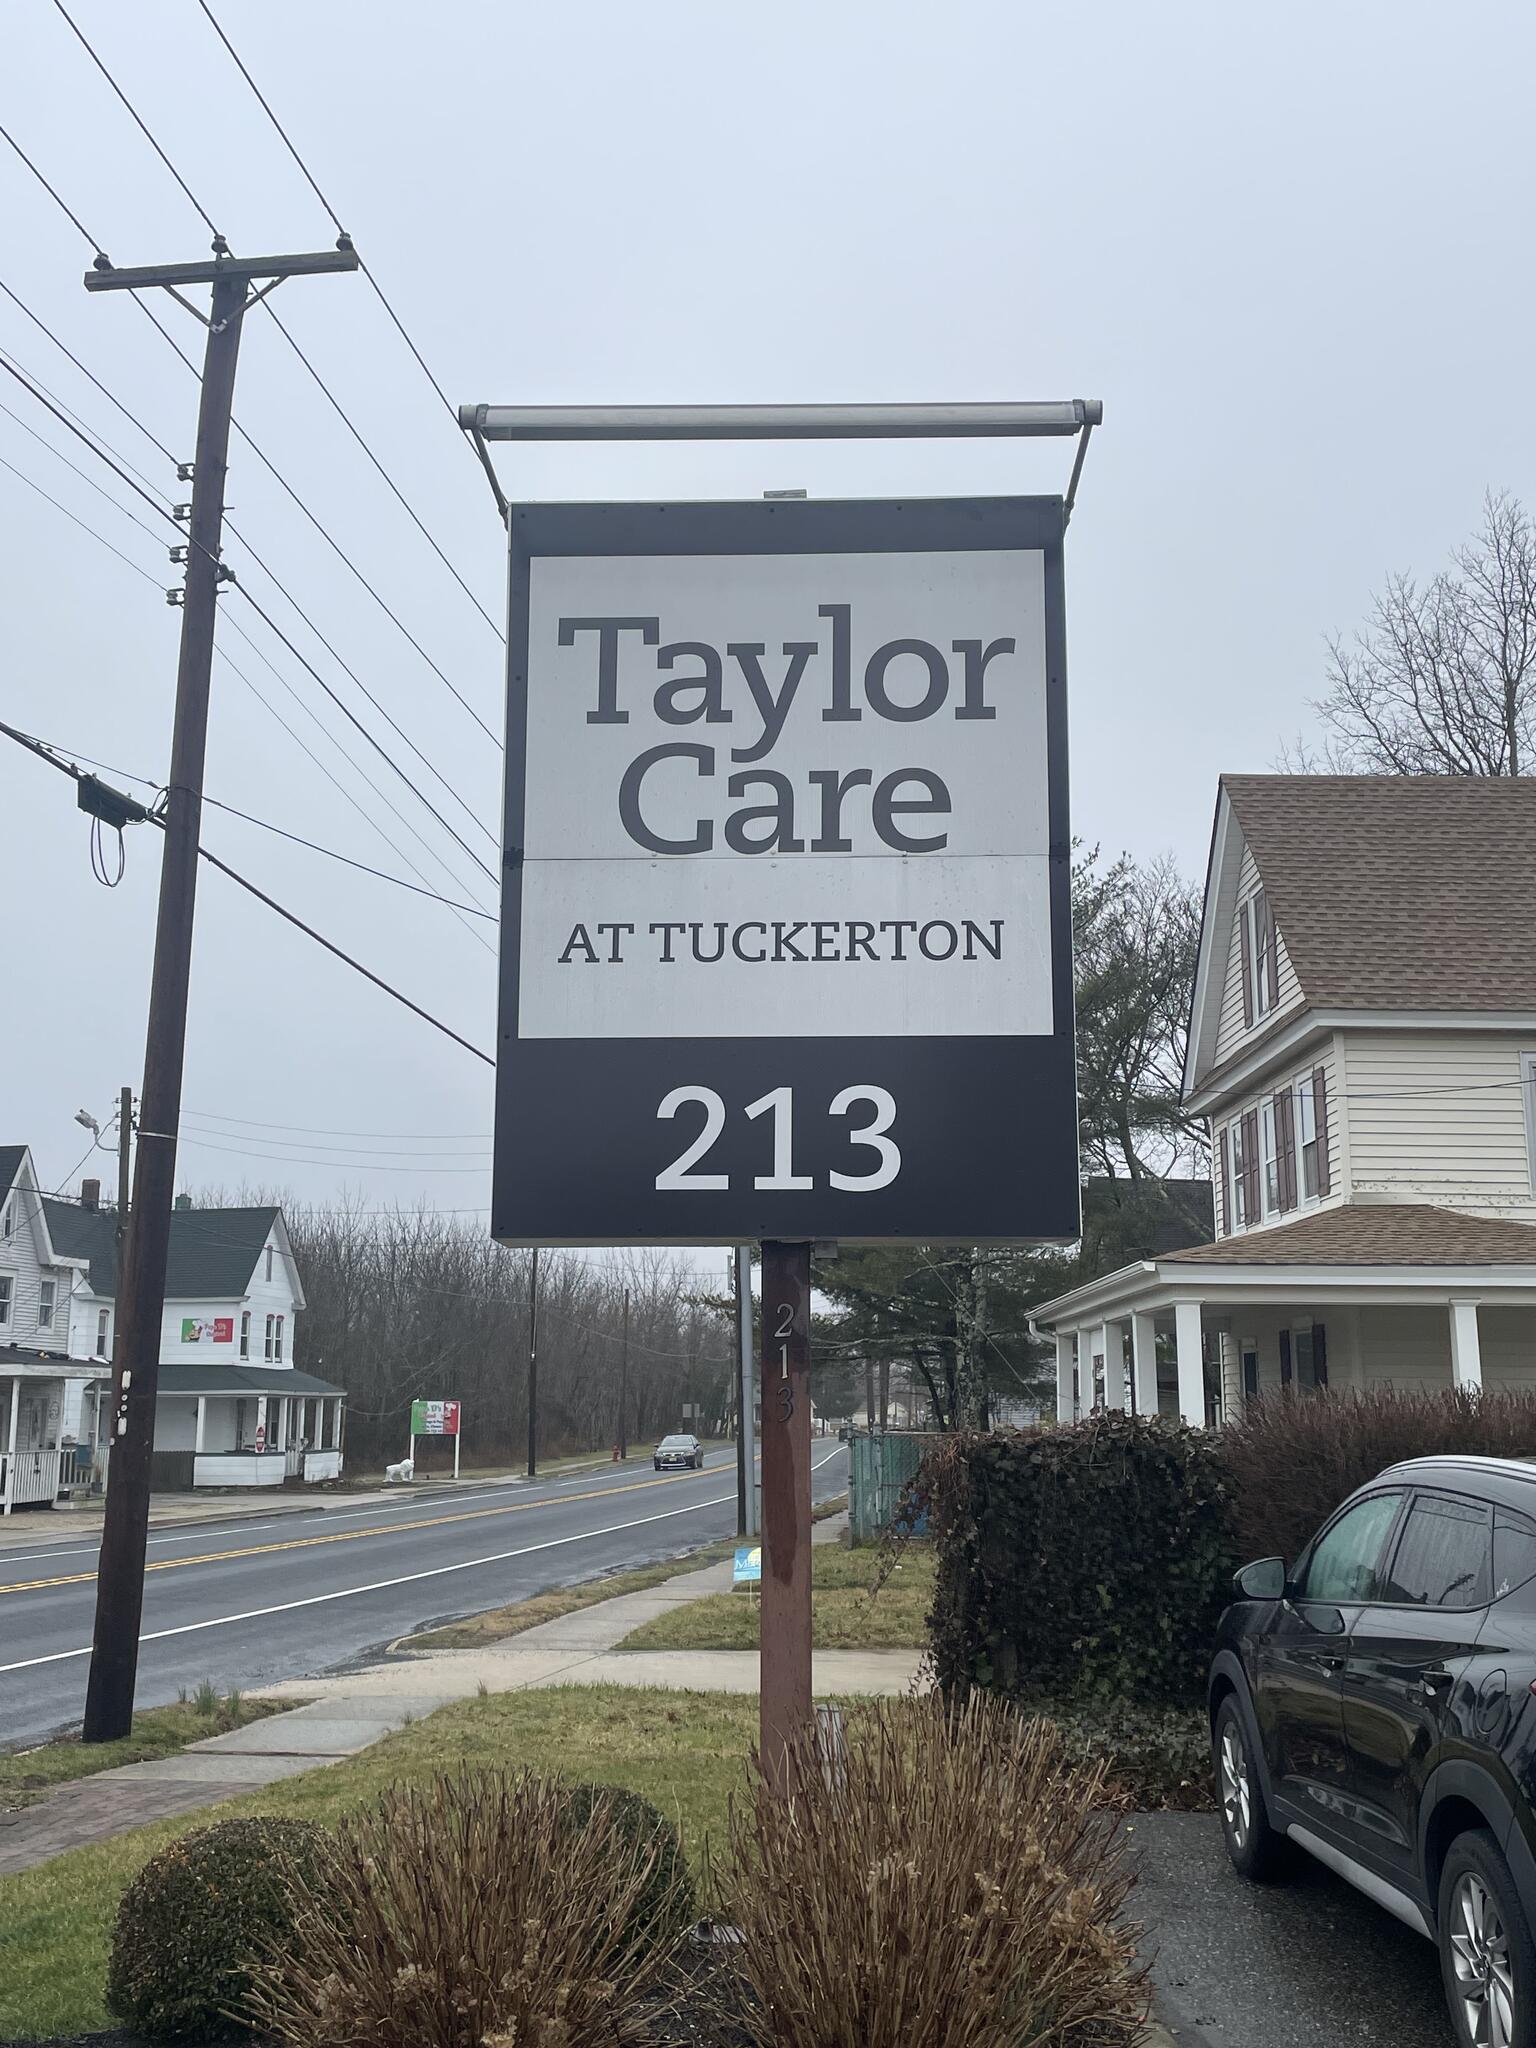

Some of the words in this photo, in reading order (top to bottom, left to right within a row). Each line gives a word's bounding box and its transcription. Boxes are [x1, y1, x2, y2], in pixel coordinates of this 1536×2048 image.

[558, 604, 1016, 763] Taylor
[619, 742, 952, 855] Care
[558, 924, 635, 964] AT
[649, 920, 1005, 964] TUCKERTON
[655, 1086, 902, 1193] 213
